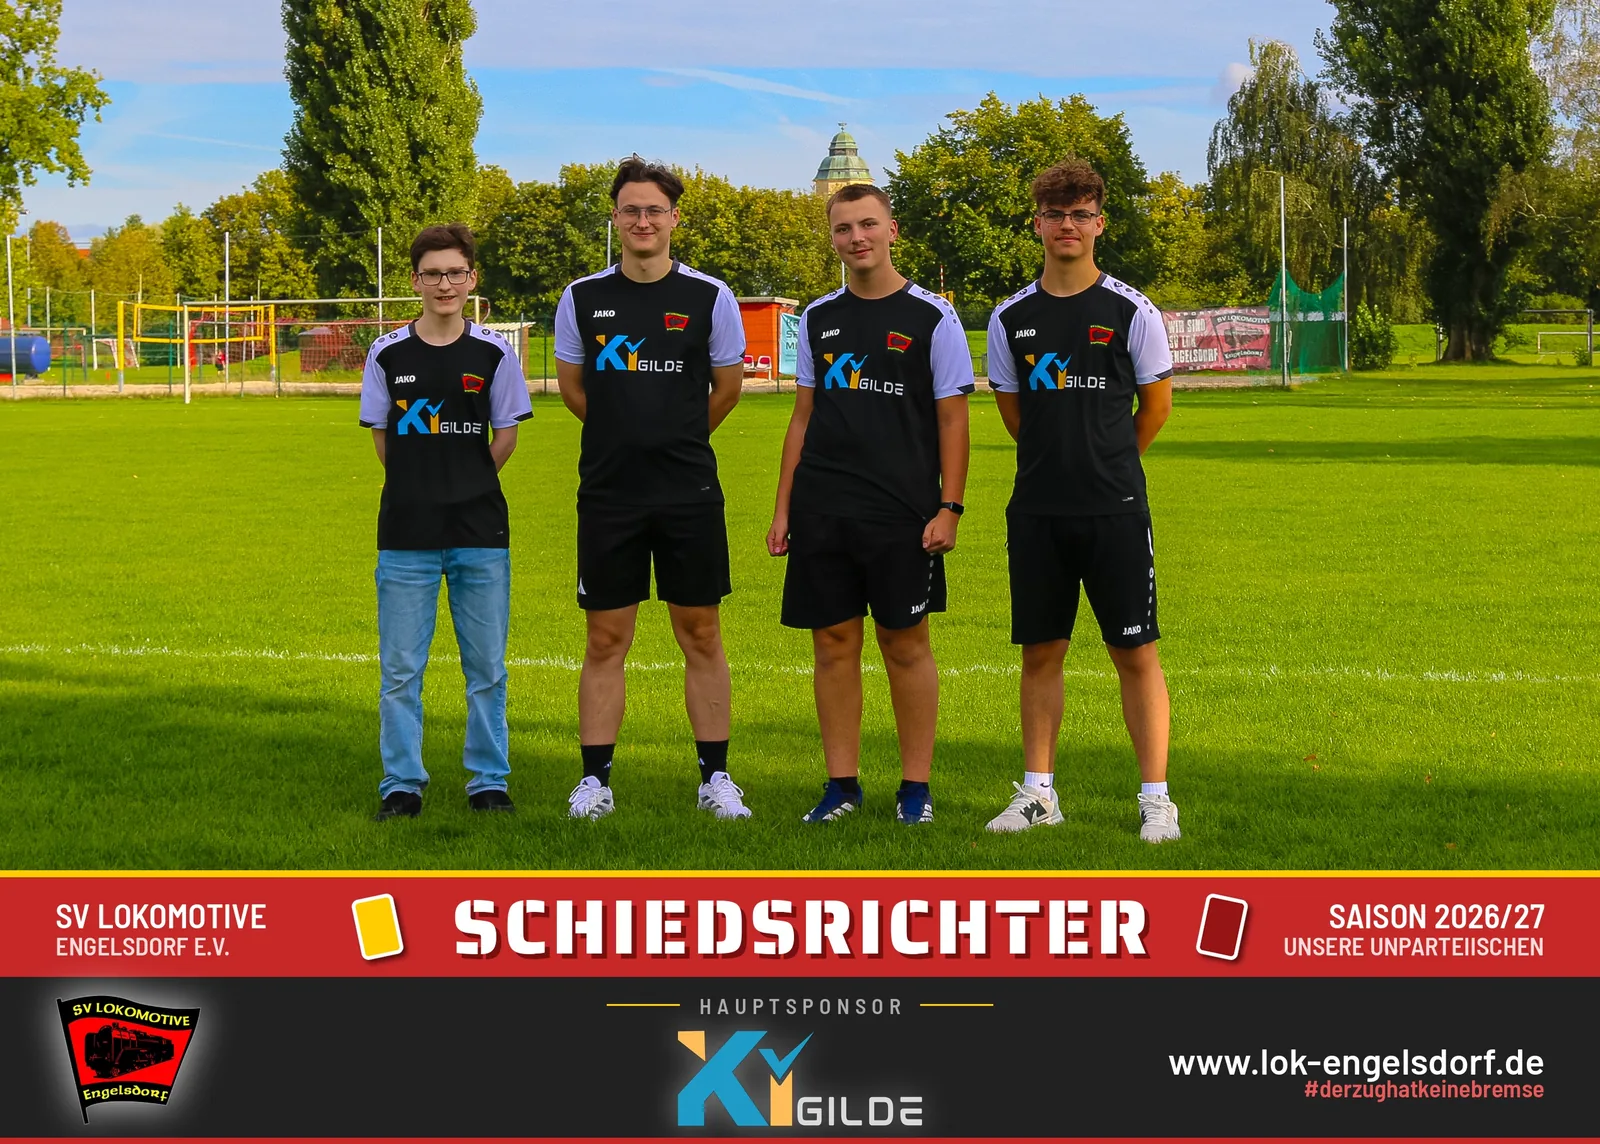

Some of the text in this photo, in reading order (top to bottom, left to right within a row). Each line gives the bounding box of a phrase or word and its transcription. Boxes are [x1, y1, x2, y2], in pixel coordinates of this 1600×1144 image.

[593, 310, 616, 318] JAKO
[1168, 318, 1206, 333] WIR SIND
[821, 328, 840, 339] JAKO
[1015, 329, 1036, 338] JAKO
[1169, 335, 1179, 348] SV
[638, 360, 684, 372] GILDE
[394, 375, 416, 384] JAKO
[1065, 375, 1106, 389] GILDE
[859, 378, 904, 396] GILDE
[440, 421, 482, 434] GILDE
[911, 601, 926, 614] JAKO
[1122, 625, 1142, 635] JAKO
